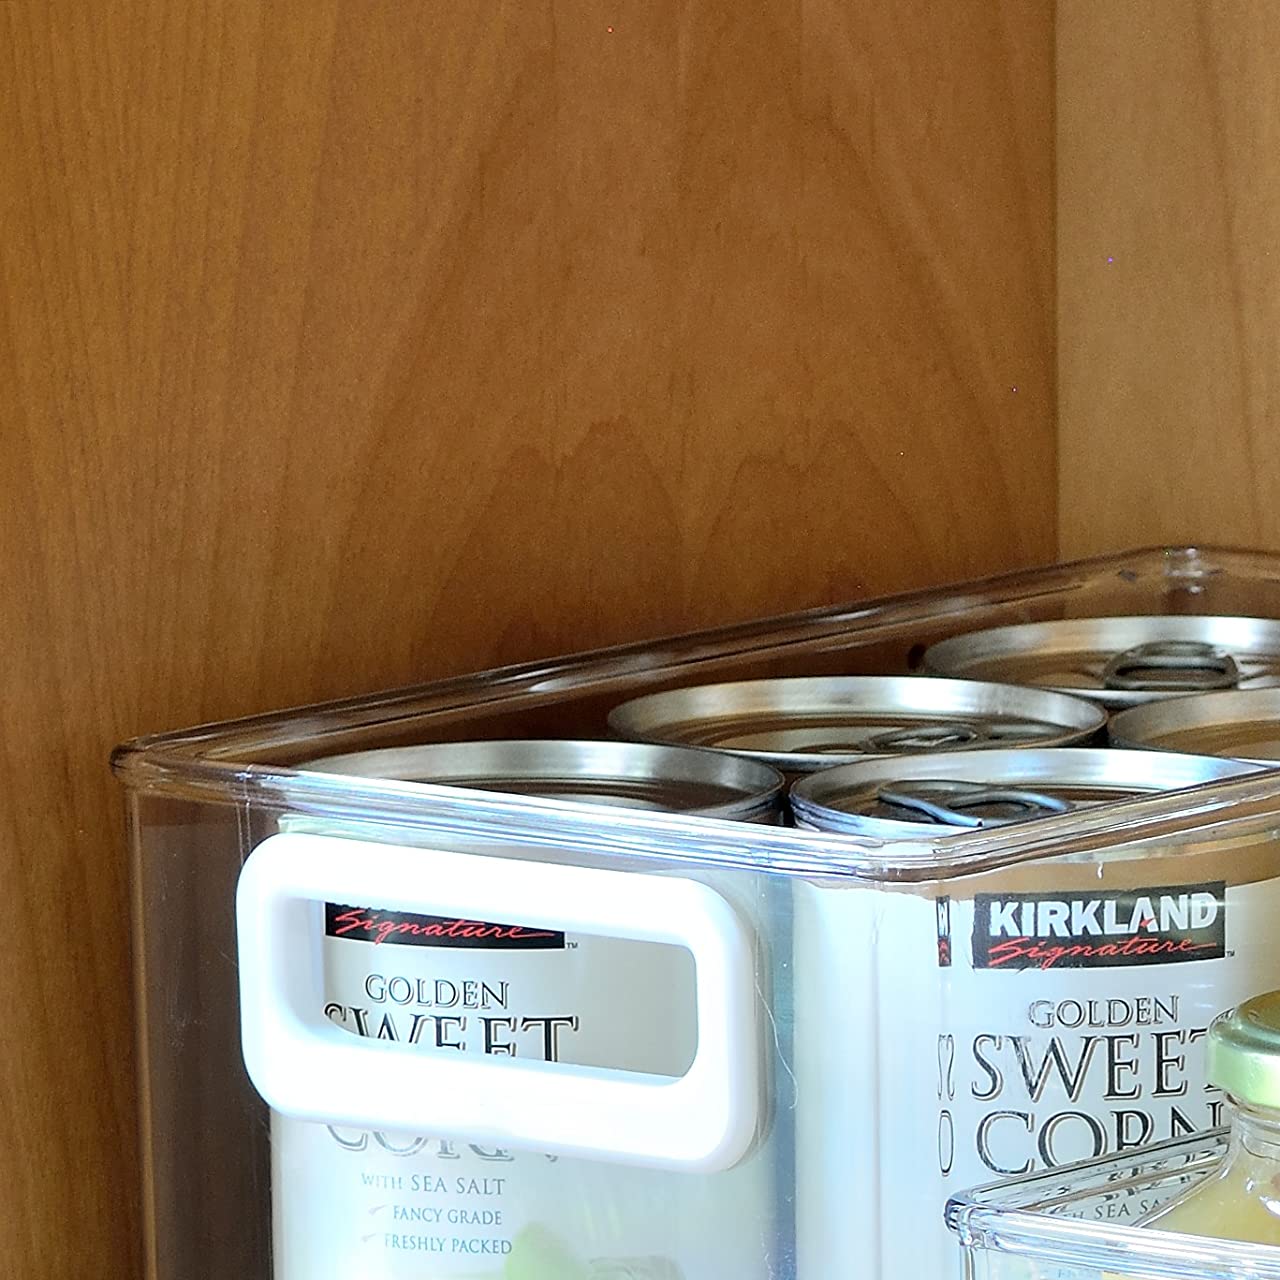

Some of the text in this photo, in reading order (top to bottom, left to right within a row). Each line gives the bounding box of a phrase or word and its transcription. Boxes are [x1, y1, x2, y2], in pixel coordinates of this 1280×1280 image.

[334, 908, 555, 944] Signature
[989, 891, 1218, 937] KIRKLAND
[987, 935, 1217, 970] Signature
[365, 974, 509, 1009] GOLDEN
[1028, 994, 1179, 1028] GOLDEN
[324, 1003, 579, 1062] WEET
[361, 1173, 505, 1196] WITH SEA SALT
[393, 1205, 502, 1225] FANCY GRADE
[1094, 1201, 1131, 1219] SEA
[385, 1233, 513, 1255] FRESHLY PACKED
